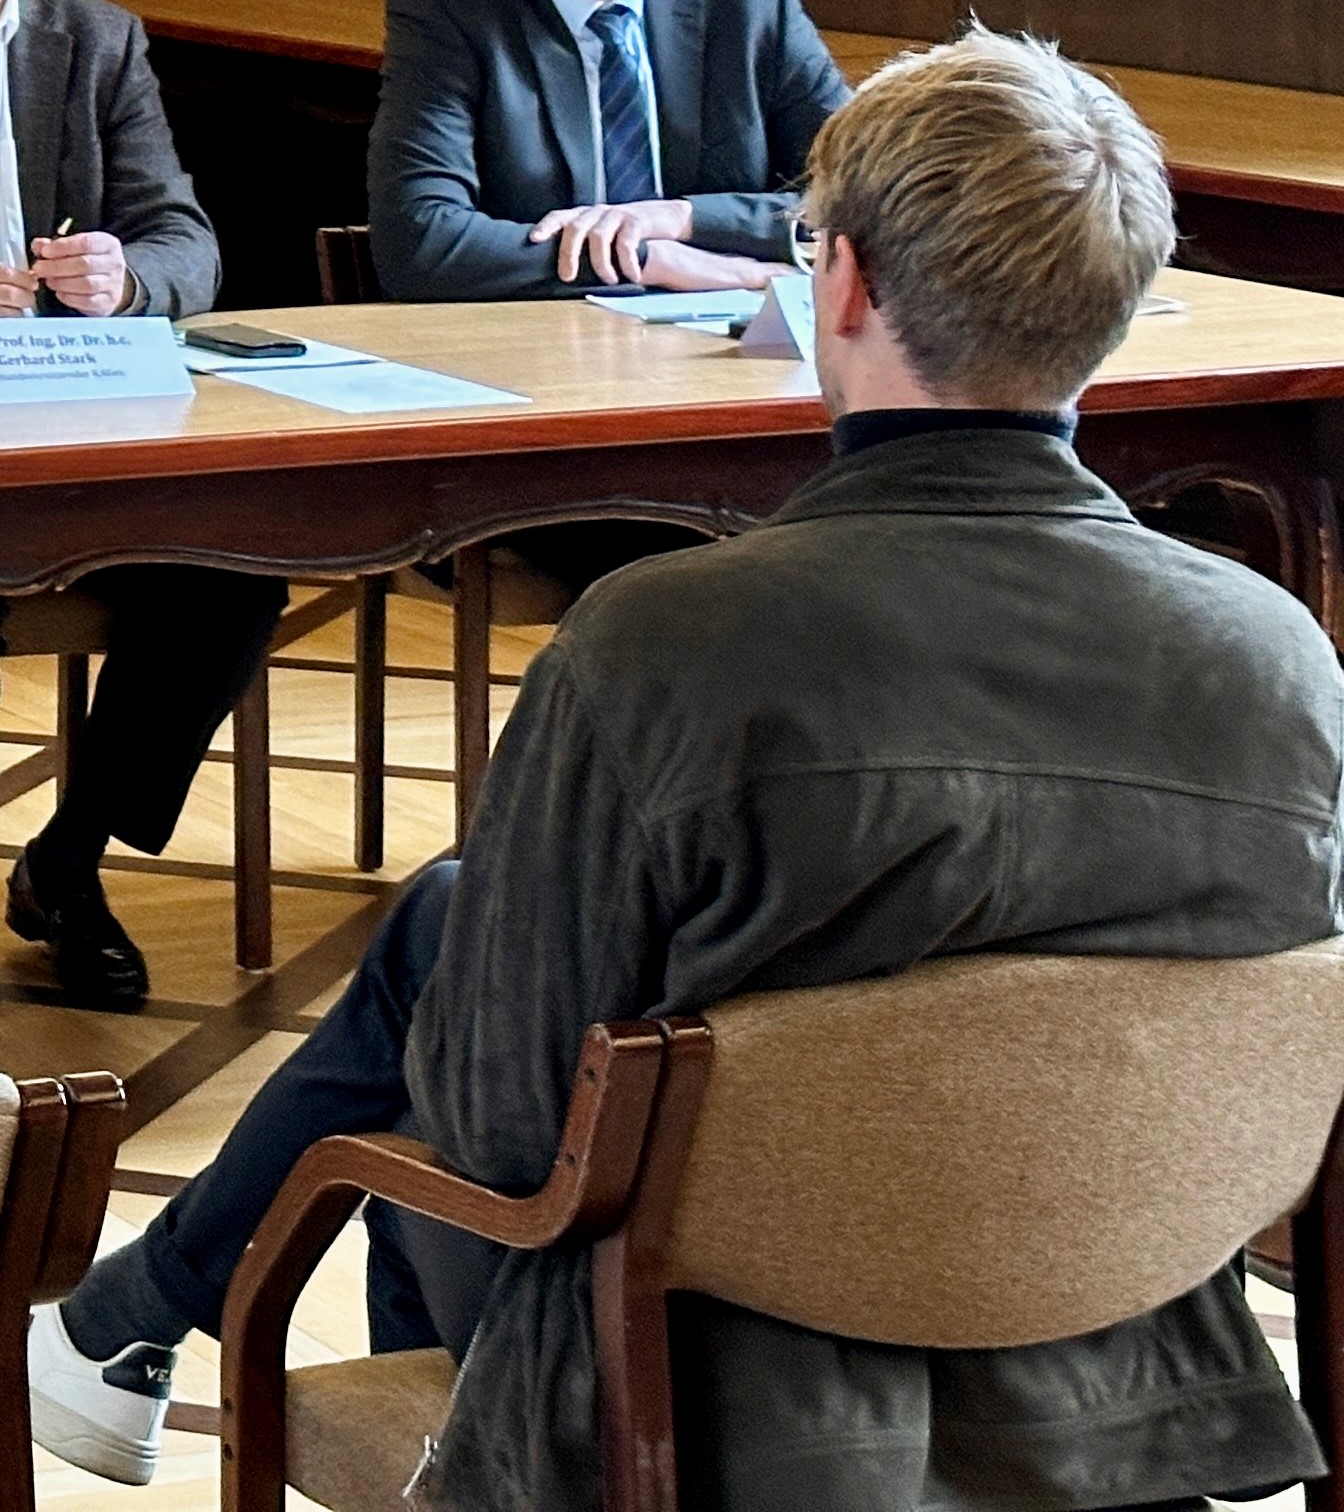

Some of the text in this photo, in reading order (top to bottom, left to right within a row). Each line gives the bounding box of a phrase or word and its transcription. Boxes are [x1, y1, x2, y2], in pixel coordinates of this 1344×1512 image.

[58, 334, 80, 348] Dr.
[81, 334, 105, 347] Dr.
[58, 352, 97, 365] Stark
